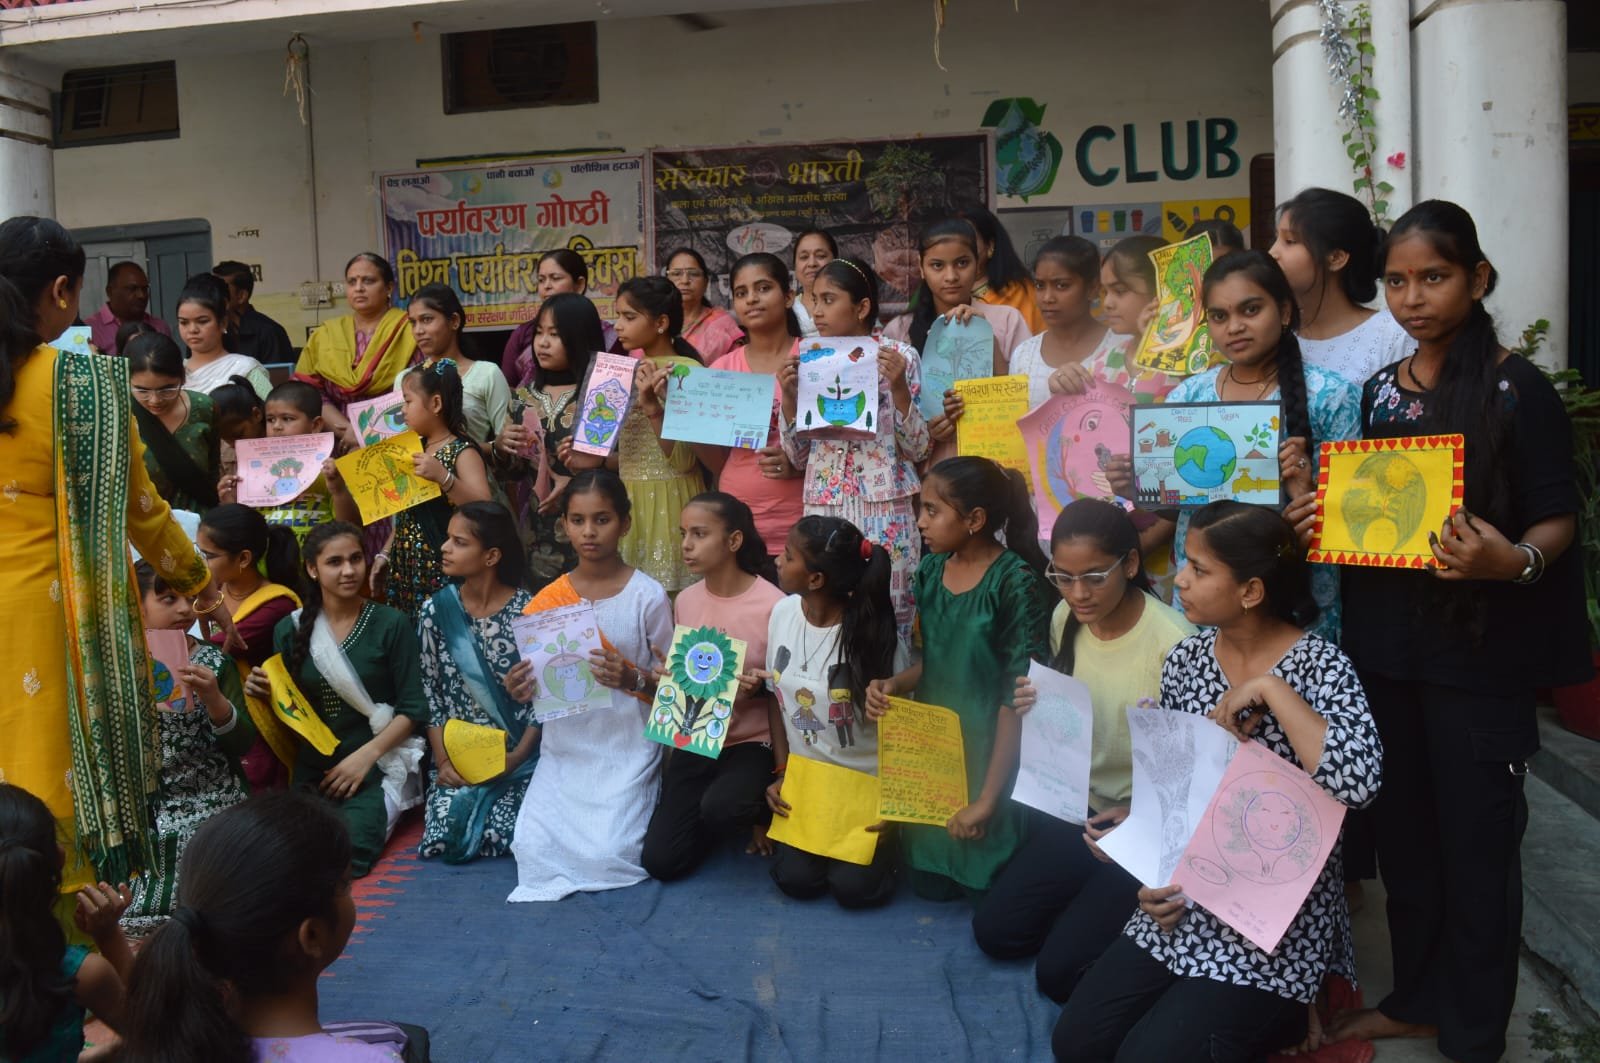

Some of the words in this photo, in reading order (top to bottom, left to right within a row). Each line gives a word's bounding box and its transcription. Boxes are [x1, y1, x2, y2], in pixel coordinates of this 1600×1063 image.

[612, 159, 640, 171] हटाओ
[655, 160, 748, 190] संस्कार
[787, 149, 864, 185] भारती
[1075, 117, 1241, 187] CLUB
[416, 201, 528, 236] पर्यावरण
[536, 190, 610, 227] गोष्ठी
[456, 242, 541, 294] पर्यावर
